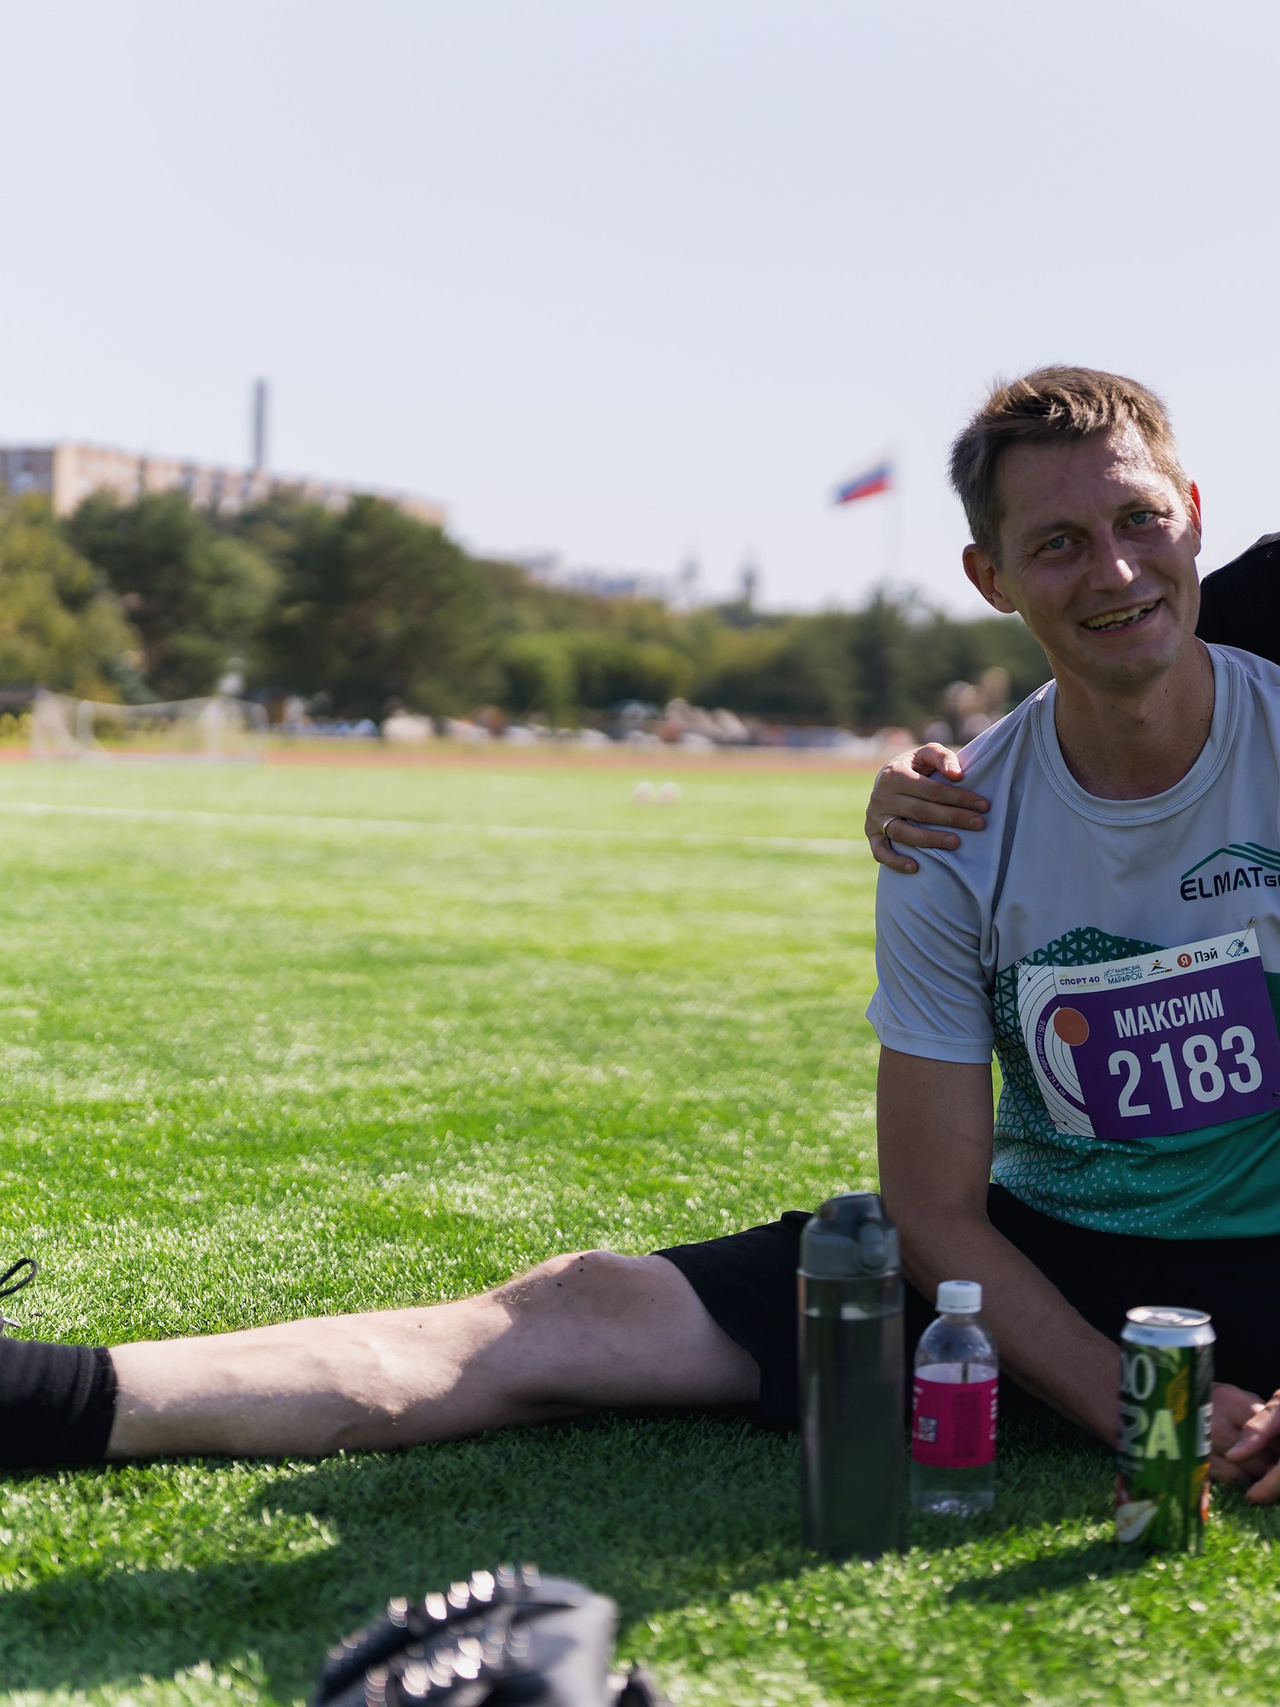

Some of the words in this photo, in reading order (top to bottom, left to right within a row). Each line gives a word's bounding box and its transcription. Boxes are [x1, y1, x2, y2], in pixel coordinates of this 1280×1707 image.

[1180, 867, 1263, 901] ELMAT
[1194, 947, 1219, 964] Пэй
[1059, 976, 1087, 986] СПОРТ
[1088, 975, 1100, 984] 40
[1107, 971, 1143, 985] МАРАФОН
[1112, 988, 1225, 1039] МАКСИМ
[1107, 1025, 1263, 1118] 2183
